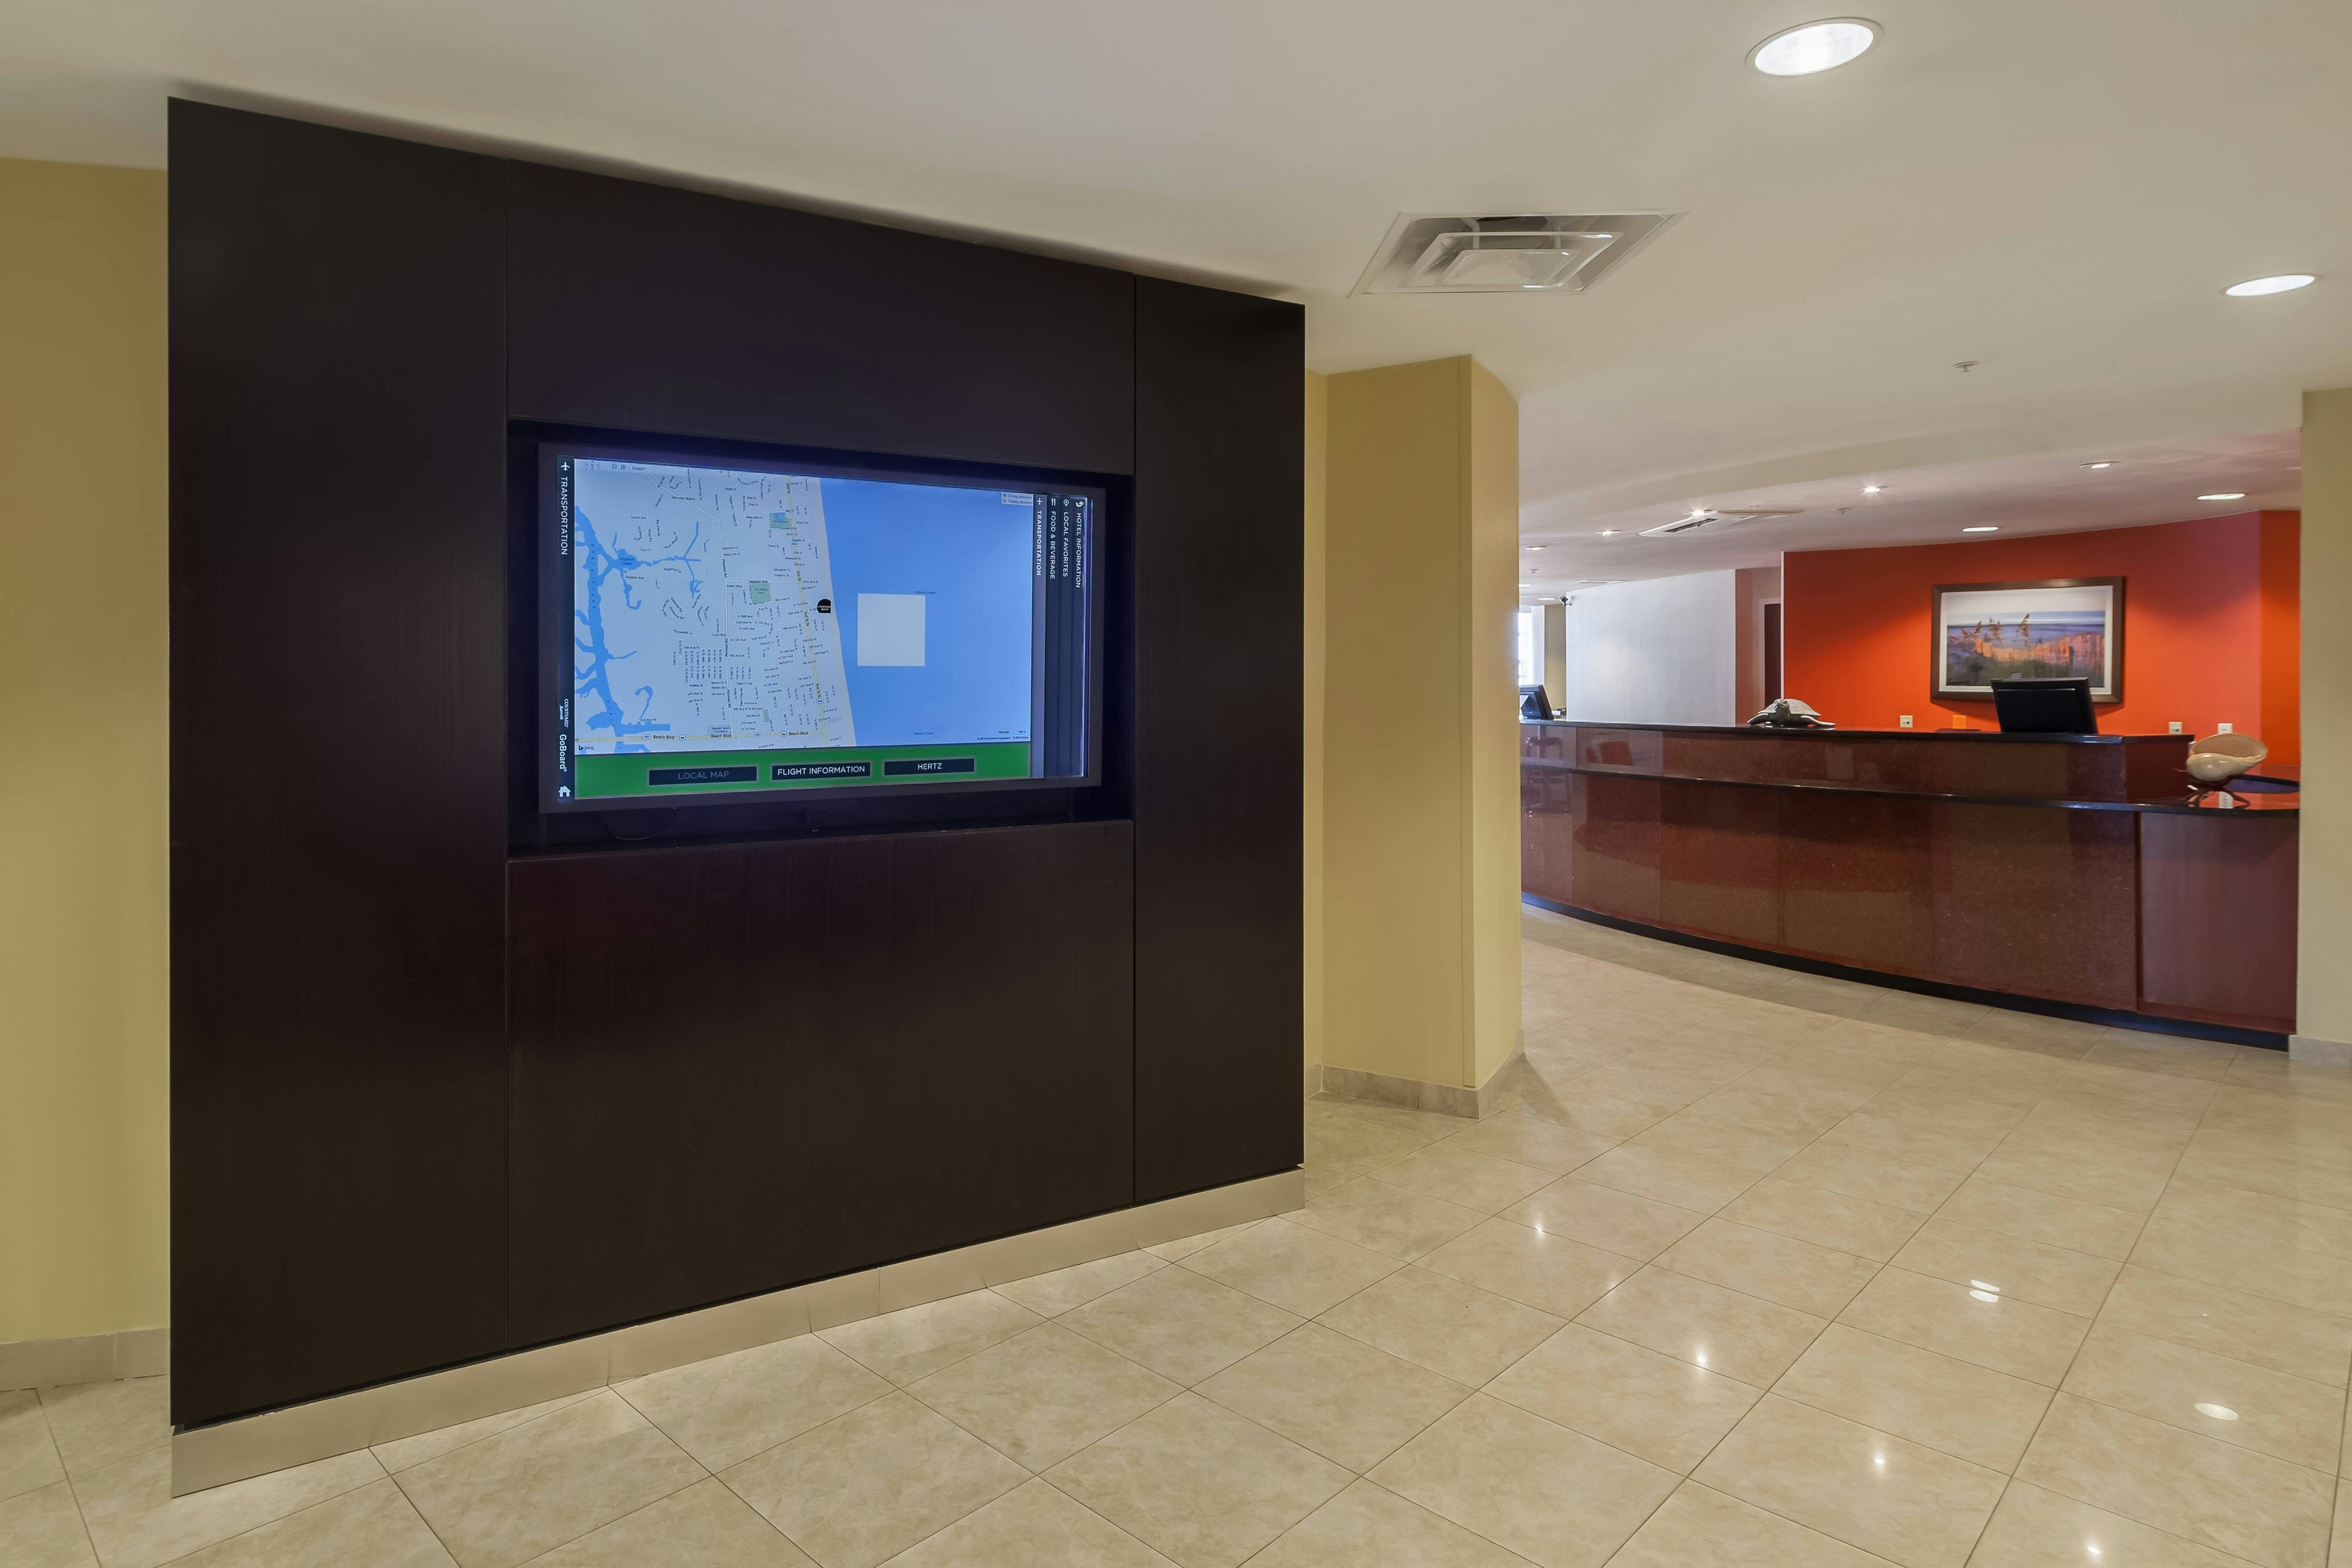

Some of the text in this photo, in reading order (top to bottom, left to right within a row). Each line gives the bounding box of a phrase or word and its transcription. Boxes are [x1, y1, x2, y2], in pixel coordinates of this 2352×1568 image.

[777, 765, 866, 776] FLIGHT INFORMATION
[917, 763, 943, 771] HERTZ
[678, 771, 729, 780] LOCAL MAP
